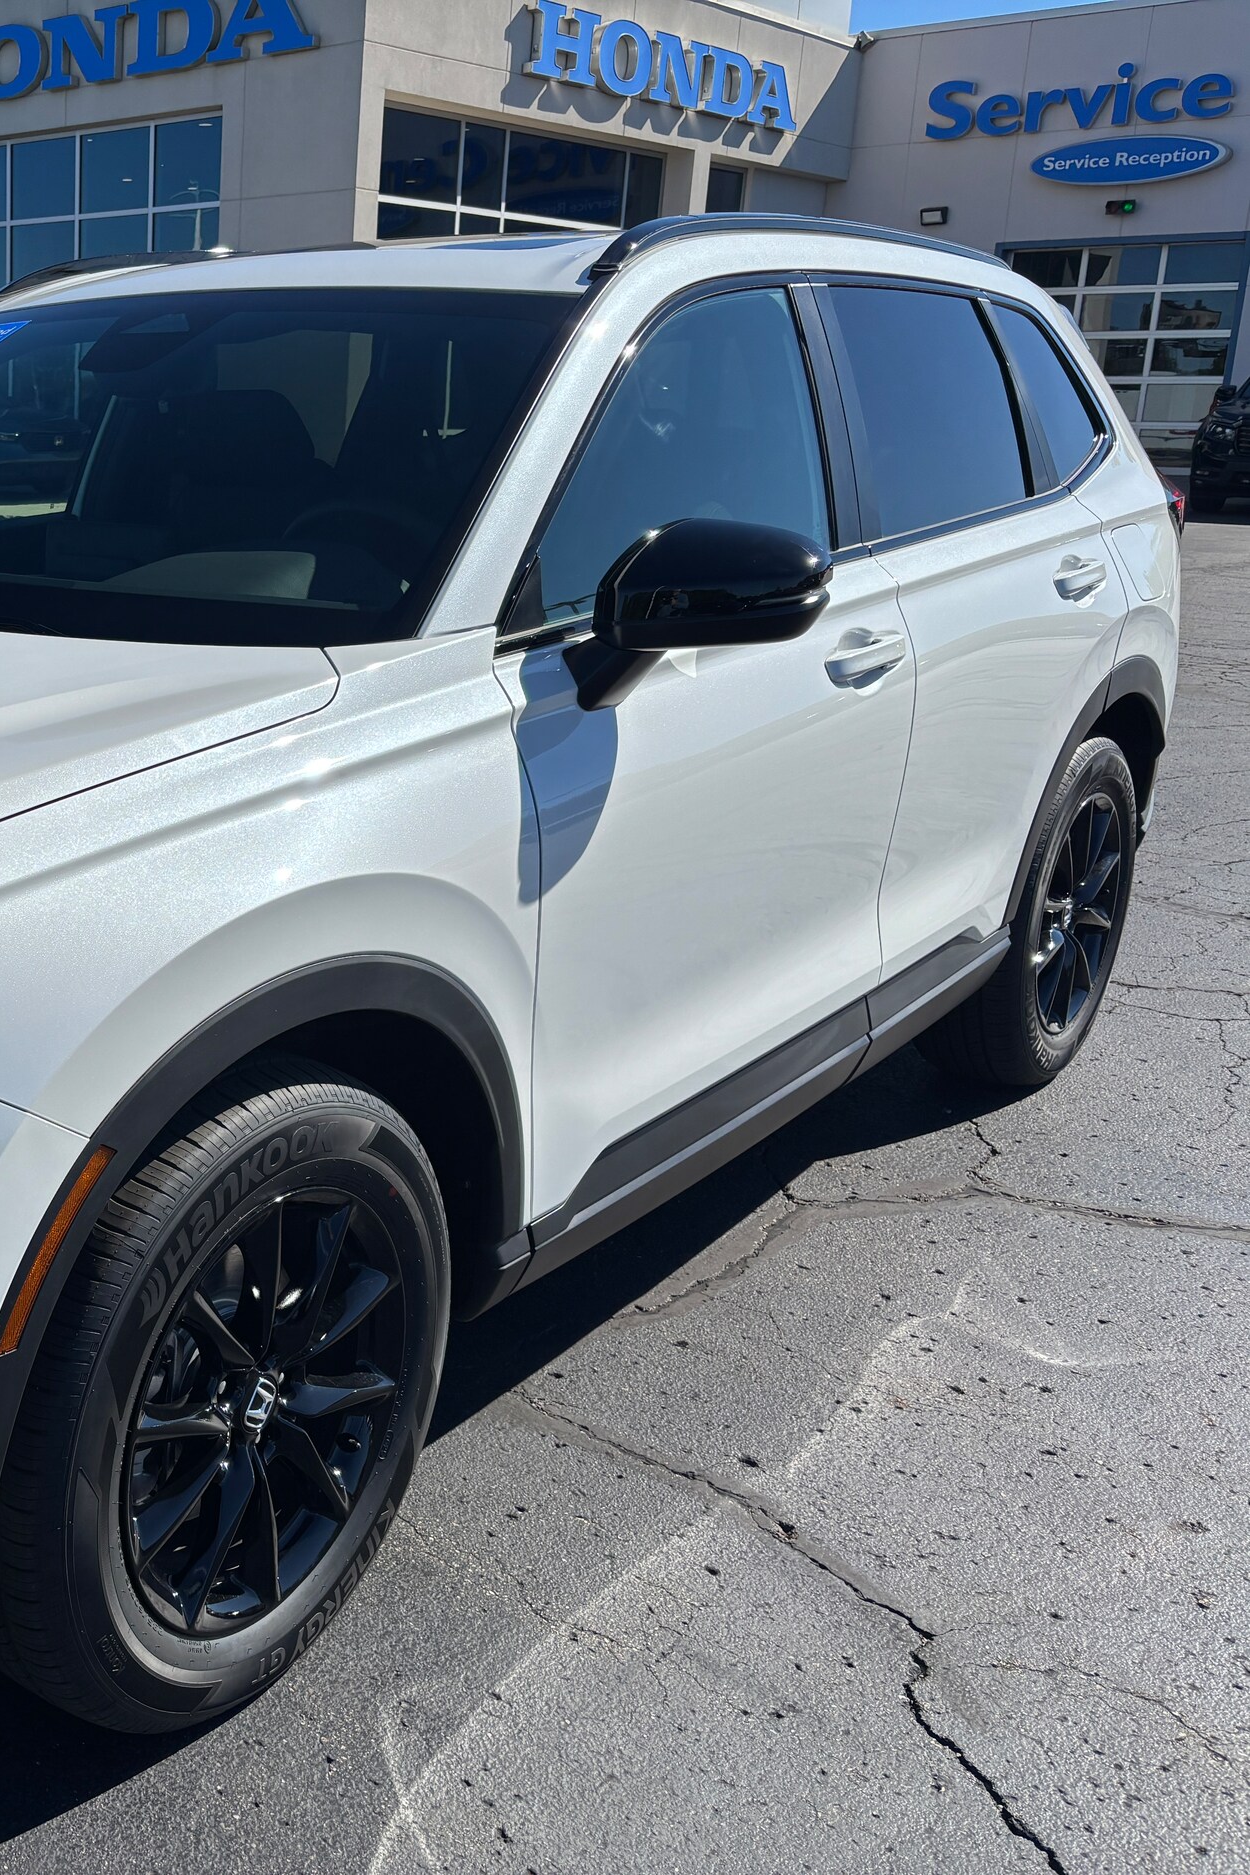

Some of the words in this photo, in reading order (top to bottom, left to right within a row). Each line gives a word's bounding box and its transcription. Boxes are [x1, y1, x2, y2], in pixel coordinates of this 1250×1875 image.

[529, 0, 797, 132] HONDA
[925, 62, 1235, 141] Service
[1042, 154, 1110, 171] Service
[1115, 147, 1211, 168] Reception
